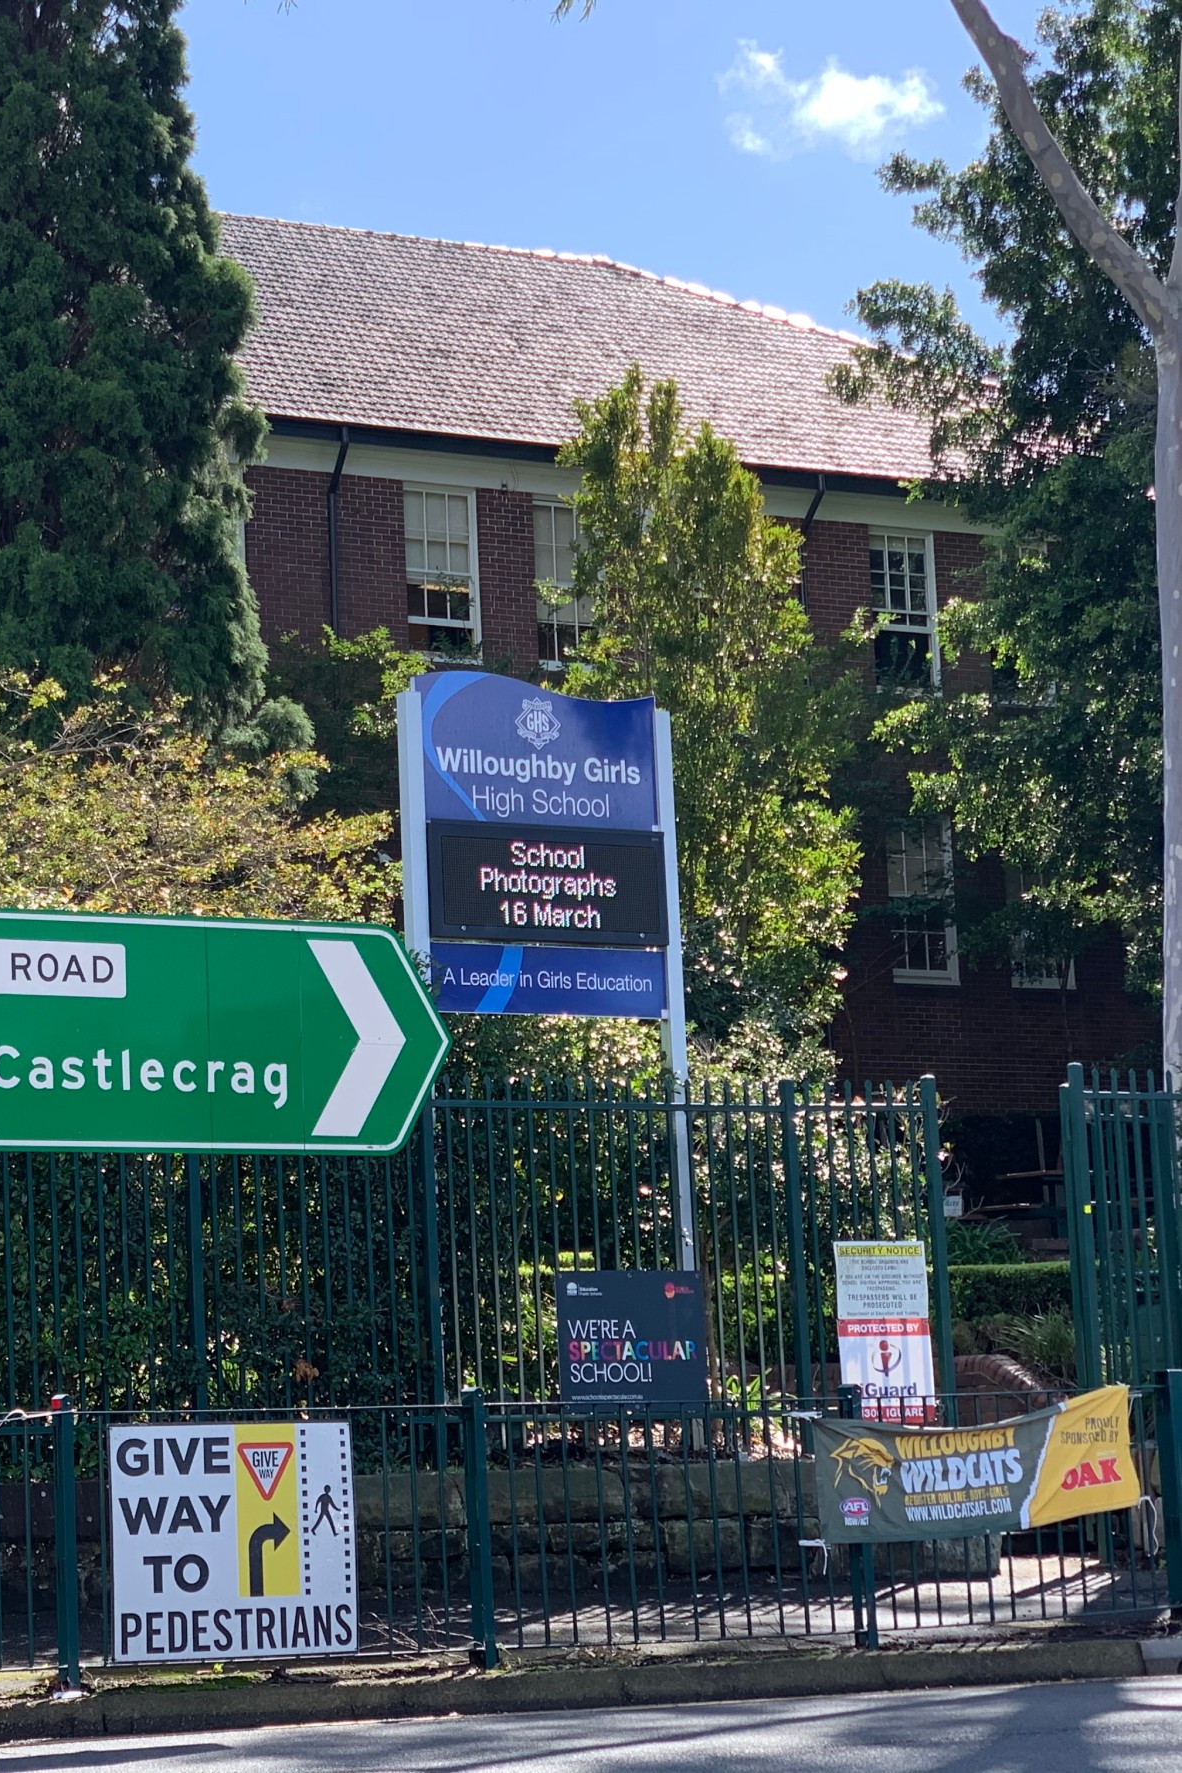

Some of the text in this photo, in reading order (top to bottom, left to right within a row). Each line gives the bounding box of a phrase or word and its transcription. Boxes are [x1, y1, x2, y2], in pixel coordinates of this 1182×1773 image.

[526, 710, 550, 734] GHS
[435, 746, 641, 785] Willoughby Girls
[471, 785, 611, 818] High School
[510, 842, 586, 869] School
[479, 867, 617, 900] Photographs
[499, 901, 602, 929] 16 March
[10, 952, 115, 984] ROAD
[443, 967, 653, 992] A Leader in Girls Education
[839, 1246, 920, 1256] SECURITY NOTICE
[567, 1319, 637, 1340] WE'RE A
[847, 1323, 920, 1333] PROTECTED BY
[568, 1340, 698, 1361] SPECTACULAR
[570, 1362, 653, 1384] SCHOOL!
[860, 1382, 917, 1397] iGuard
[116, 1436, 231, 1477] GIVE
[895, 1427, 1016, 1460] WILLOUGHBY
[251, 1450, 279, 1468] GIVE
[900, 1448, 1024, 1494] WILDCATS
[258, 1468, 275, 1479] WAY
[1060, 1457, 1123, 1491] OAK
[842, 1501, 869, 1512] AFL
[904, 1497, 1013, 1522] WWW.WILDCATSAFL.COM
[938, 1491, 967, 1504] ONLINE
[118, 1494, 232, 1536] WAY
[143, 1553, 210, 1594] TO
[120, 1604, 353, 1656] PEDESTRIANS
